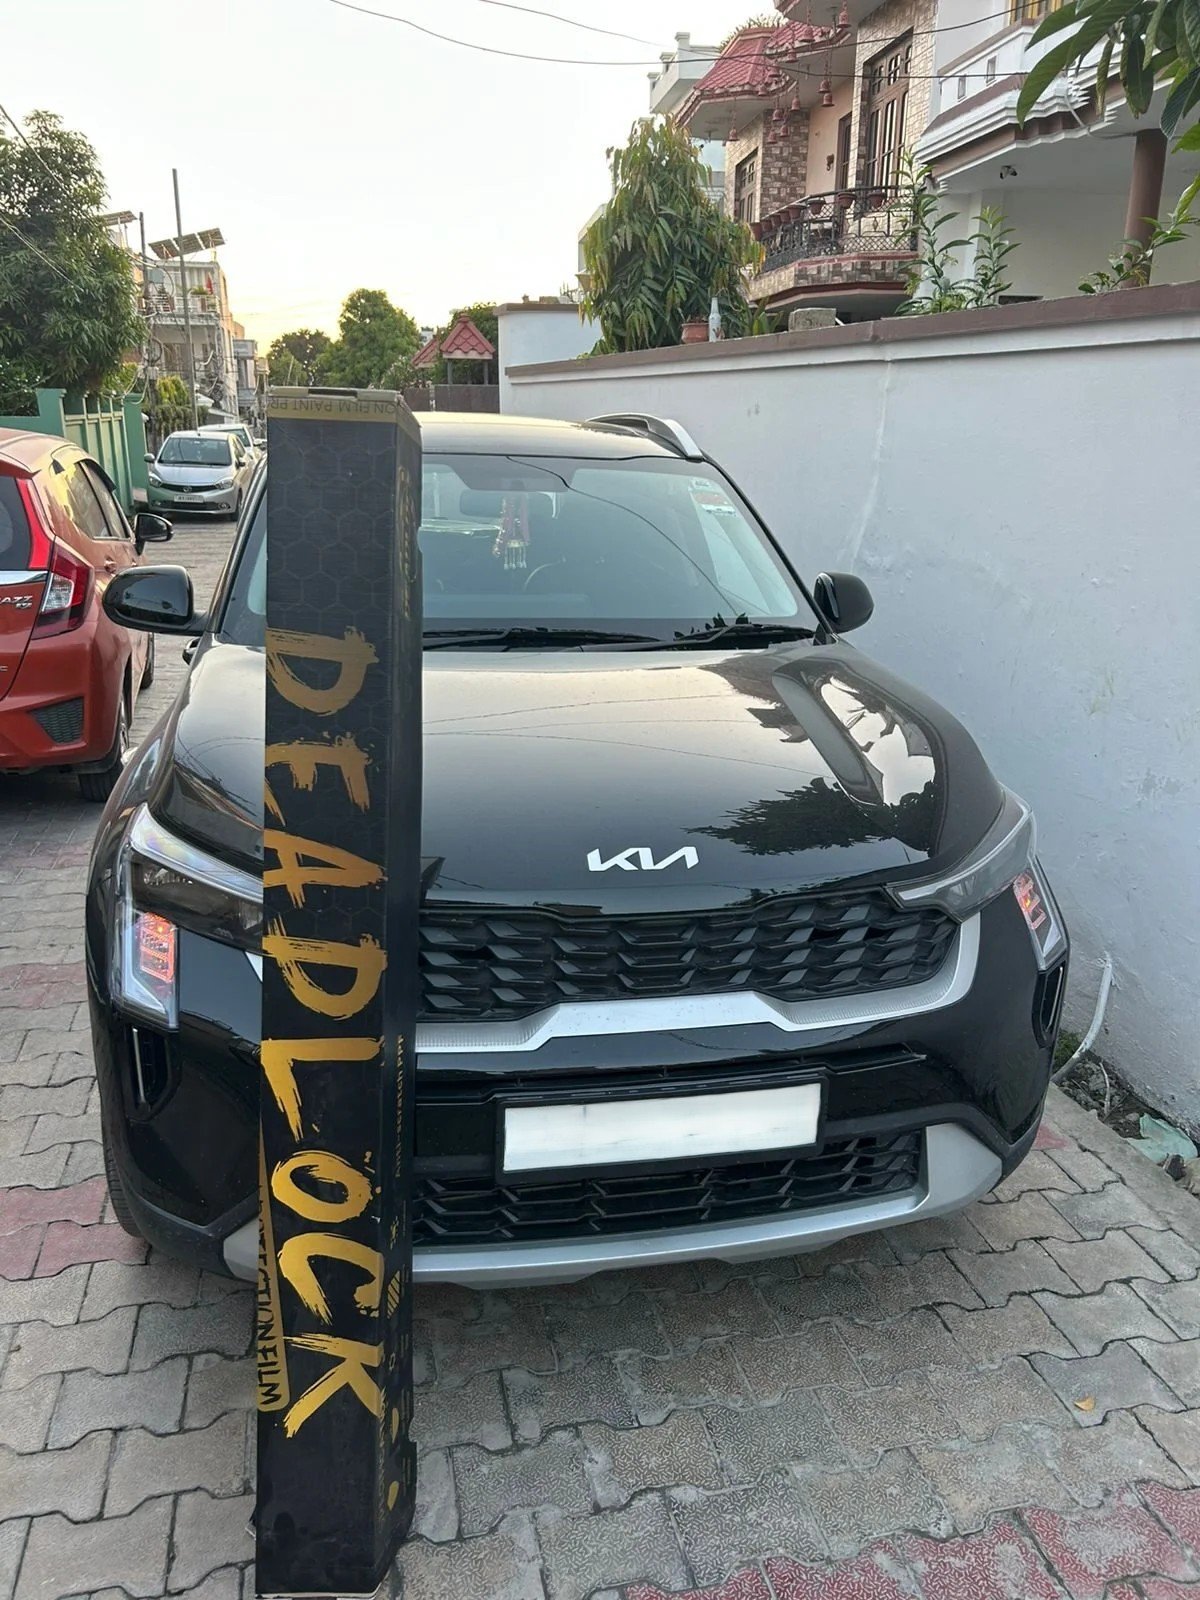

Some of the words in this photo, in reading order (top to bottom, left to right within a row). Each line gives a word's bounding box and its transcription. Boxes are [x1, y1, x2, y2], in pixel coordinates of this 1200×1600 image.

[292, 398, 333, 413] PAINT
[338, 400, 369, 414] FILM
[0, 595, 33, 604] AZZ
[586, 846, 699, 871] KIA
[260, 625, 388, 1439] DEADLOCK
[256, 1344, 283, 1405] FILM
